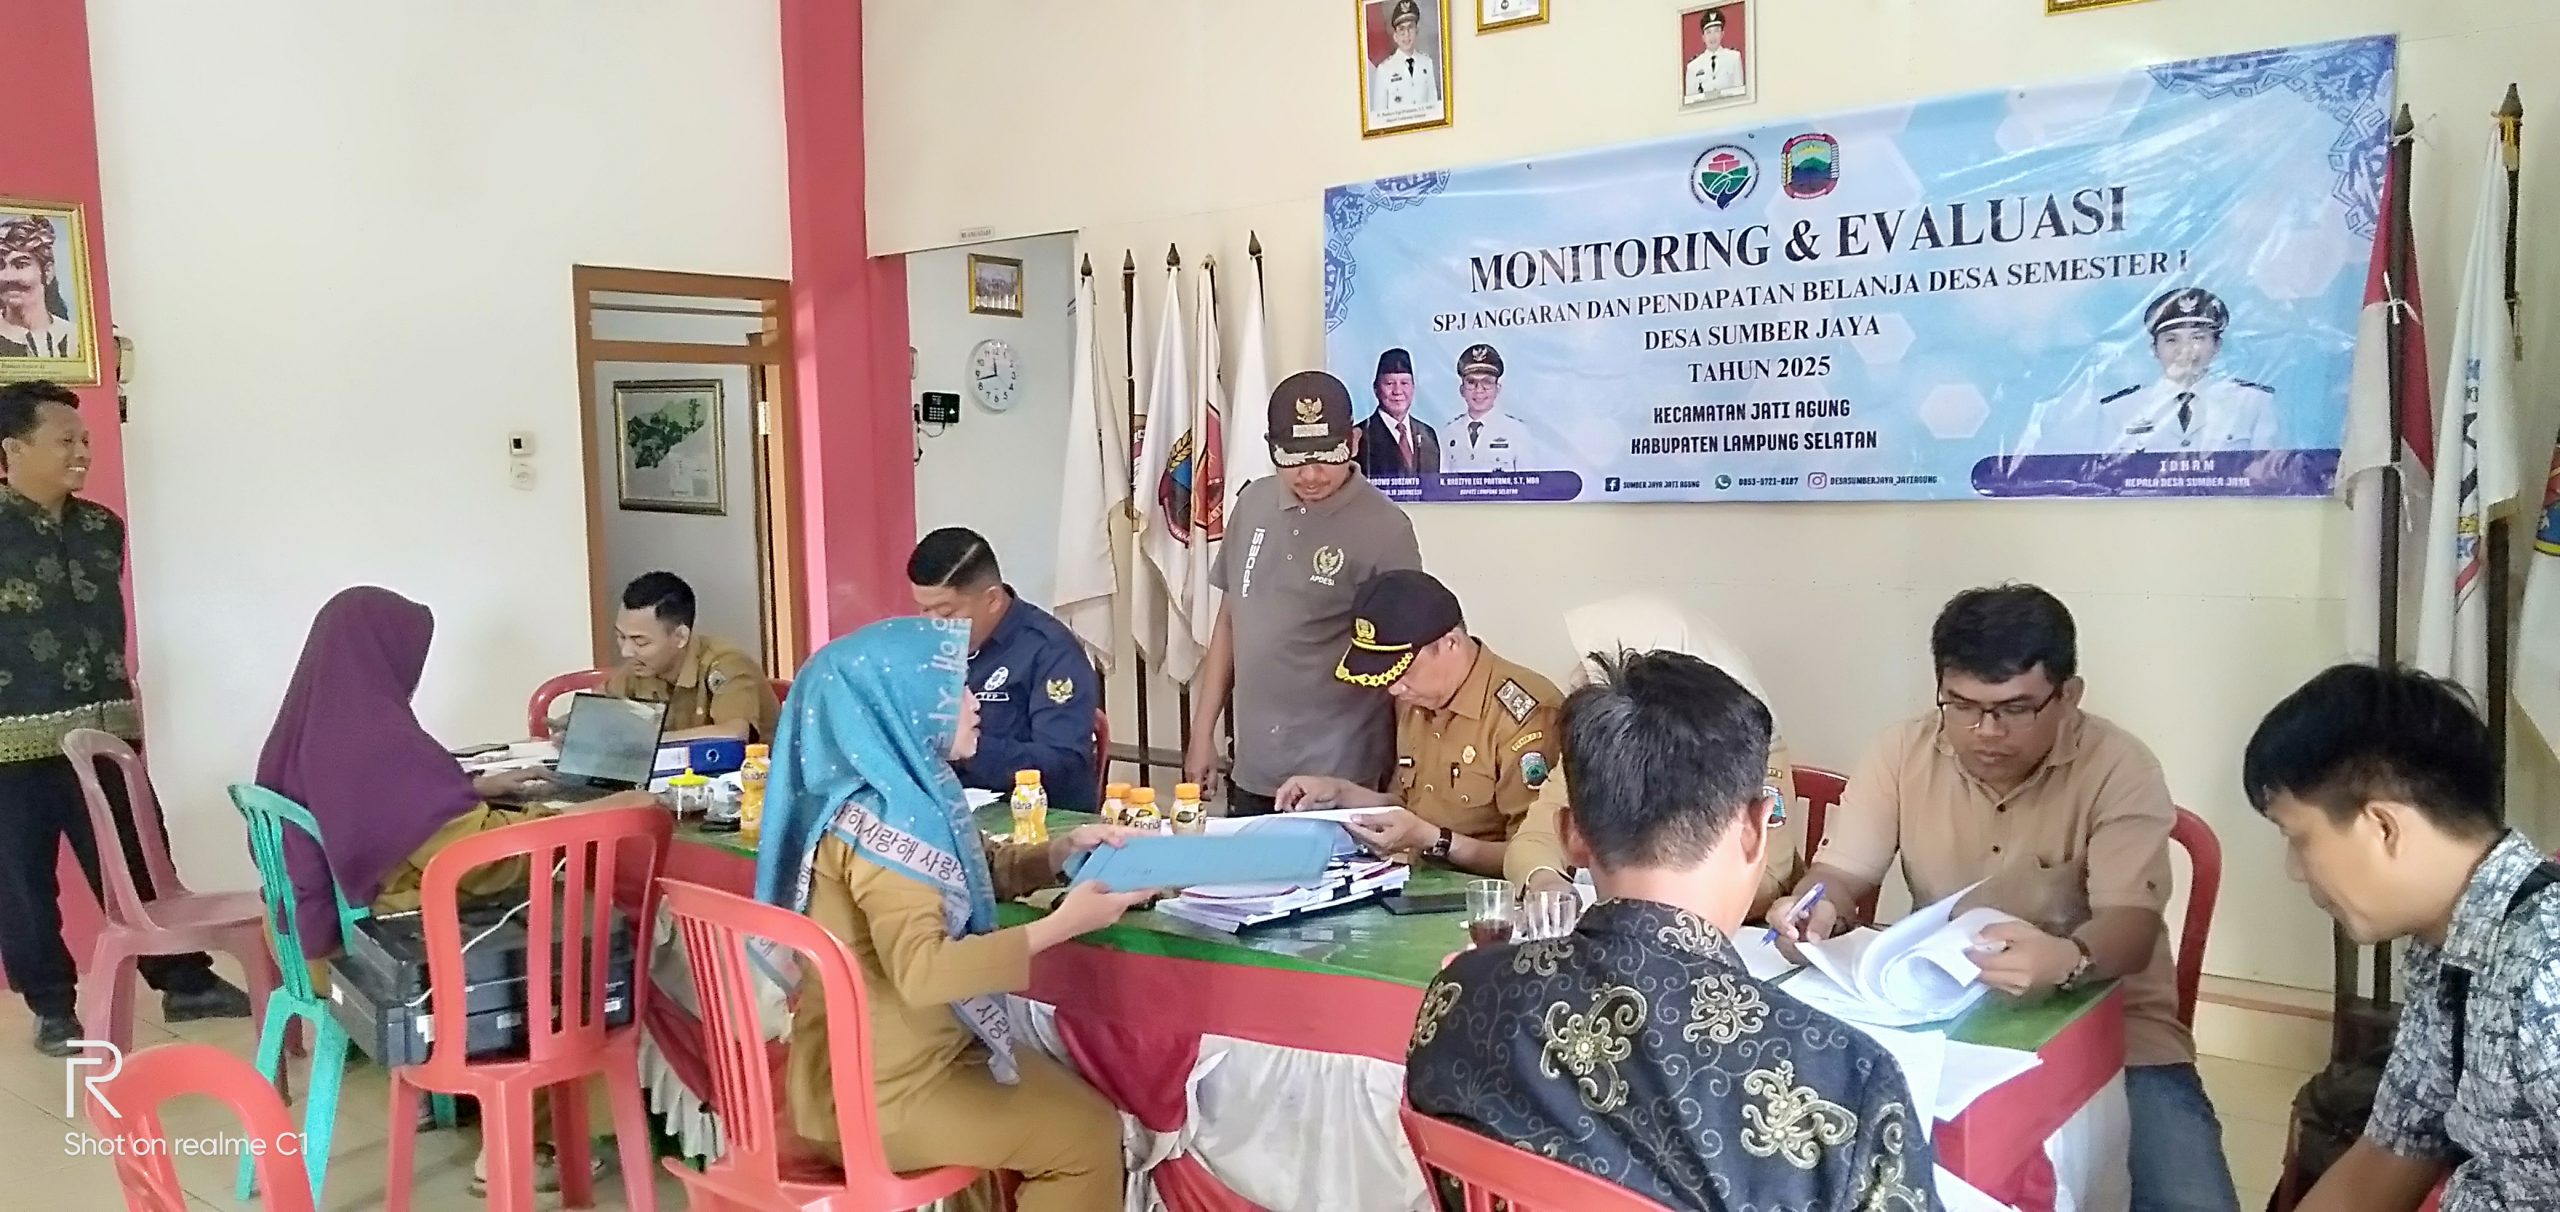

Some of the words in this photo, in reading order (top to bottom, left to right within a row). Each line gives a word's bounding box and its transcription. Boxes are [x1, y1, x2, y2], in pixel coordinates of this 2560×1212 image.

[1470, 224, 1769, 293] MONITORING
[1785, 218, 1821, 262] &
[1837, 186, 2128, 258] EVALUASI
[1433, 312, 1467, 332] SPJ
[1471, 301, 1582, 329] ANGGARAN
[1587, 297, 1631, 320] DAN
[1638, 282, 1795, 315] PENDAPATAN
[1803, 271, 1920, 301] BELANJA
[1929, 266, 1999, 292] DESA
[2007, 251, 2168, 286] SEMESTER
[1645, 329, 1701, 350] DESA
[1708, 320, 1809, 346] SUMBER
[1816, 315, 1881, 339] JAYA
[1011, 371, 1016, 380] 3
[1688, 359, 1771, 383] TAHUN
[1777, 355, 1831, 378] 2025
[986, 391, 991, 399] 7
[1003, 391, 1008, 400] 5
[1654, 404, 1746, 424] KECAMATAN
[1750, 401, 1790, 420] JATI
[1795, 399, 1850, 419] AGUNG
[1631, 436, 1718, 454] KABUPATEN
[1723, 433, 1799, 452] LAMPUNG
[1804, 430, 1877, 450] SELATAN
[2160, 477, 2185, 487] DESA
[2186, 477, 2224, 487] SUMBER
[1242, 527, 1266, 598] APDESI
[1310, 574, 1335, 586] APDESI
[863, 822, 919, 864] 사랑해
